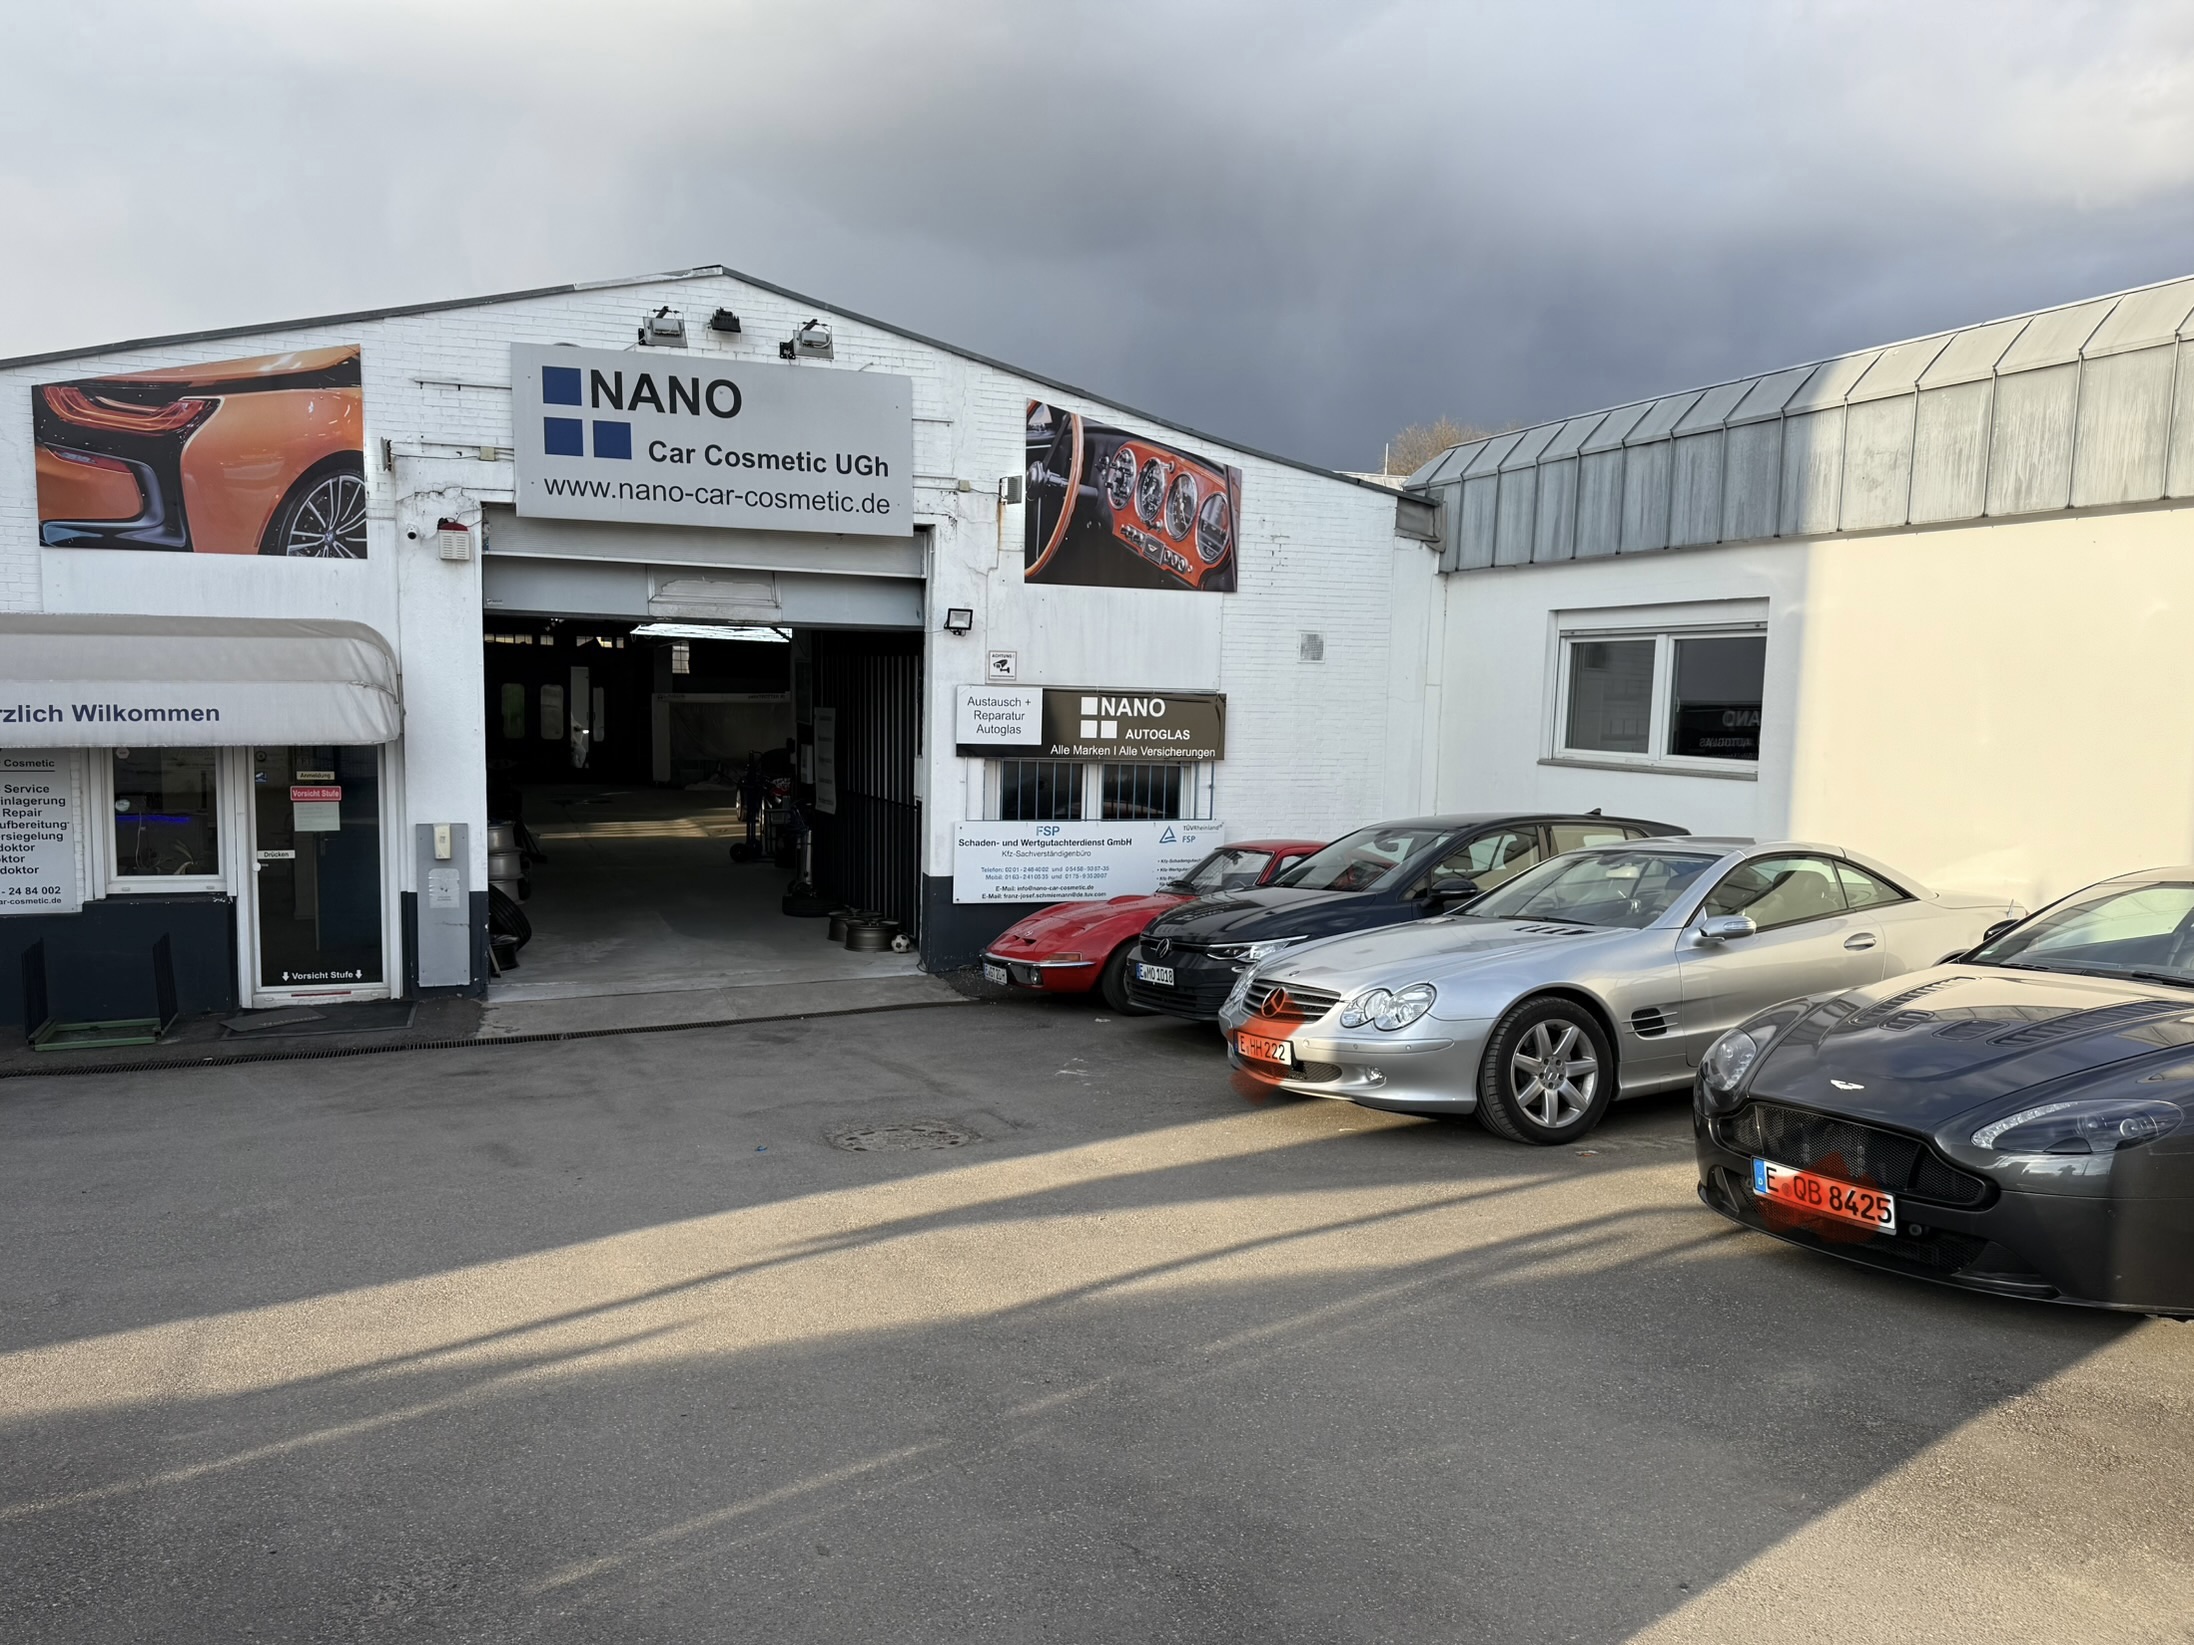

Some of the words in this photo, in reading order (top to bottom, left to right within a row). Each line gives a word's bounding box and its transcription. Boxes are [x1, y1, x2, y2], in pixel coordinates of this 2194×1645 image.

[590, 368, 742, 419] NANO
[648, 439, 695, 465] Car
[704, 443, 827, 474] Cosmetic
[835, 453, 889, 477] UGh
[543, 478, 891, 514] www.nano-car-cosmetic.de
[966, 696, 1022, 707] Austausch
[71, 704, 220, 722] Wilkommen
[1100, 697, 1166, 718] NANO
[973, 710, 1026, 722] Reparatur
[976, 724, 1022, 737] Autoglas
[1124, 729, 1191, 741] AUTOGLAS
[1050, 744, 1070, 756] Alle
[1072, 744, 1111, 756] Marken
[1118, 746, 1138, 757] Alle
[1140, 746, 1216, 759] Versicherungen
[3, 758, 55, 768] Cosmetic
[4, 784, 50, 794] Service
[292, 789, 320, 798] Vorsicht
[321, 789, 340, 798] Stufe
[2, 808, 43, 819] Repair
[1035, 825, 1061, 837] FSP
[958, 838, 1000, 848] Schaden-
[1002, 839, 1019, 847] und
[1021, 838, 1105, 849] Wertgutachterdienst
[1106, 838, 1132, 847] GmbH
[1182, 835, 1197, 843] FSP
[0, 854, 26, 864] ktor
[263, 850, 290, 858] Drücken
[1001, 849, 1092, 859] Kfz-Sachverständigenbüro
[0, 865, 40, 875] doktor
[8, 886, 22, 896] 24
[25, 886, 39, 896] 84
[41, 885, 62, 896] 002
[291, 971, 329, 980] Vorsicht
[330, 970, 354, 979] Stufe
[1156, 967, 1174, 984] 1018
[1240, 1035, 1246, 1053] E
[1249, 1037, 1263, 1058] HH
[1264, 1041, 1286, 1061] 222
[1766, 1166, 1779, 1193] E
[1793, 1175, 1823, 1206] QB
[1828, 1185, 1893, 1224] 8425
